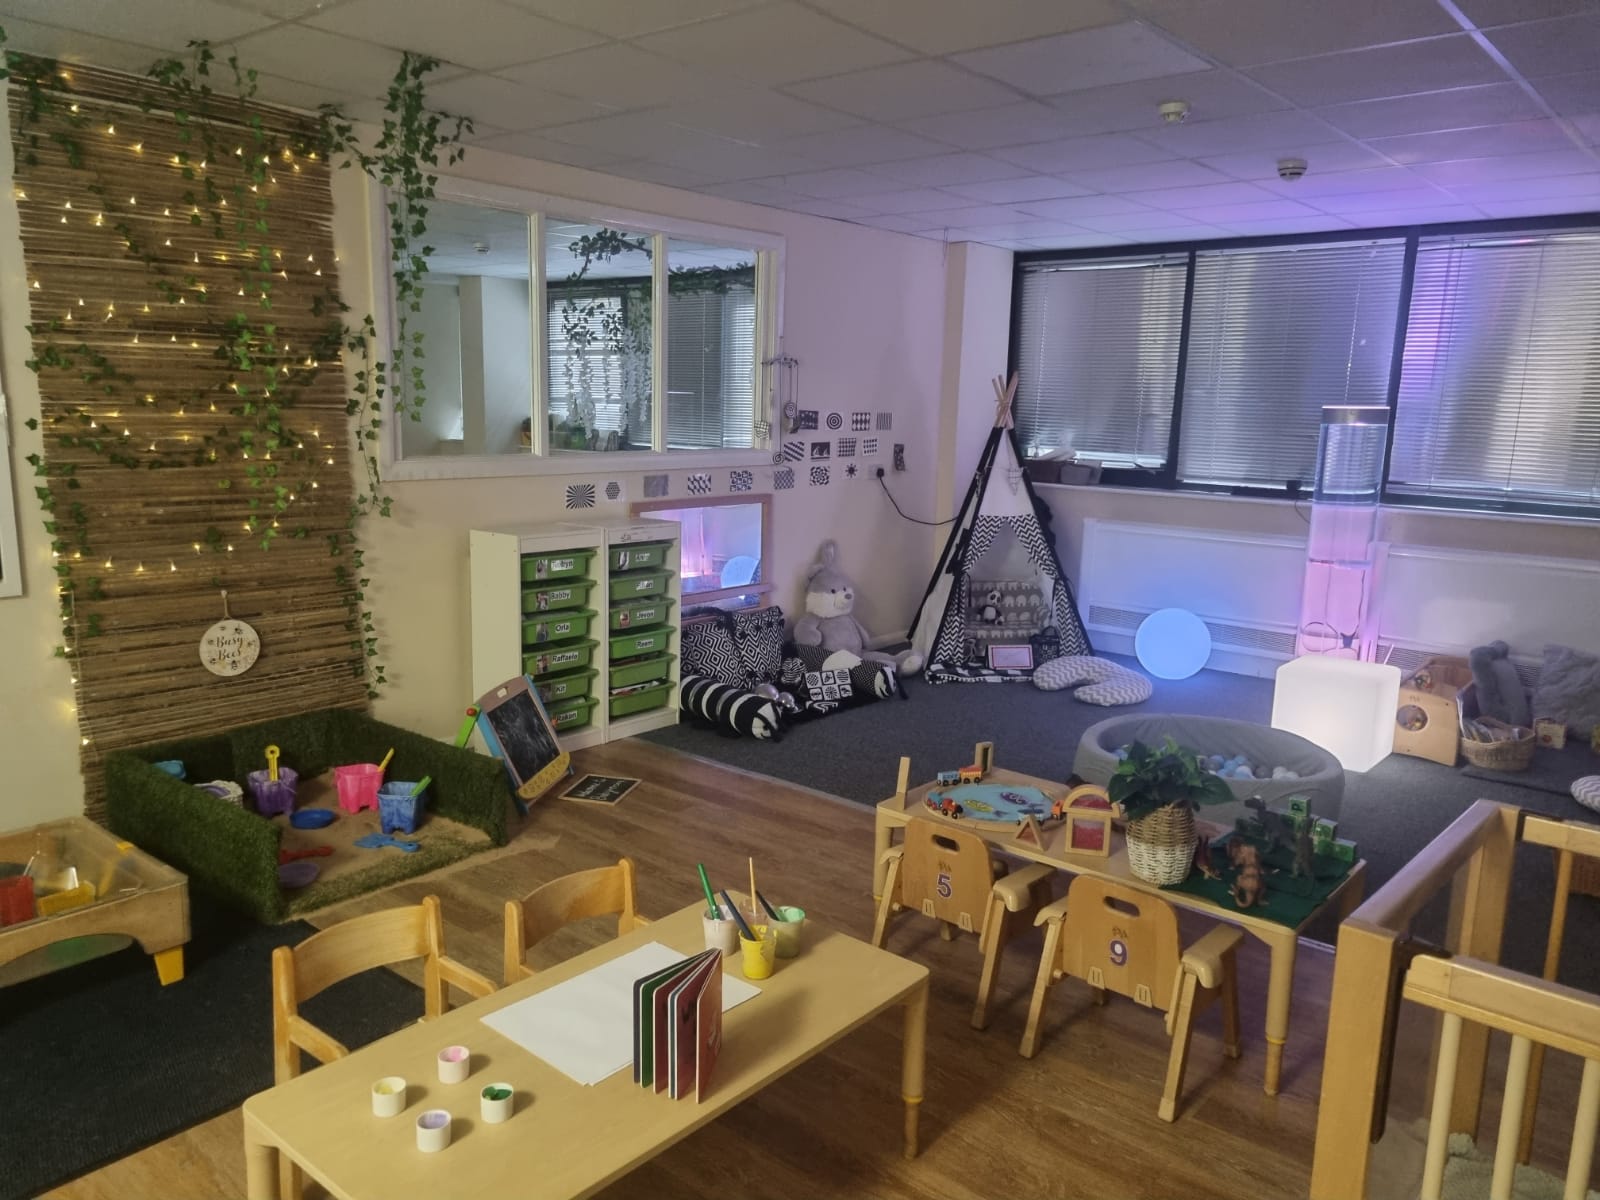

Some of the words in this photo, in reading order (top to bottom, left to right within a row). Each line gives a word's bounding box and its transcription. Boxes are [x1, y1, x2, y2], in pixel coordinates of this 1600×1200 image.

[555, 623, 569, 632] Orla
[937, 873, 952, 898] 5
[1110, 939, 1128, 966] 9
